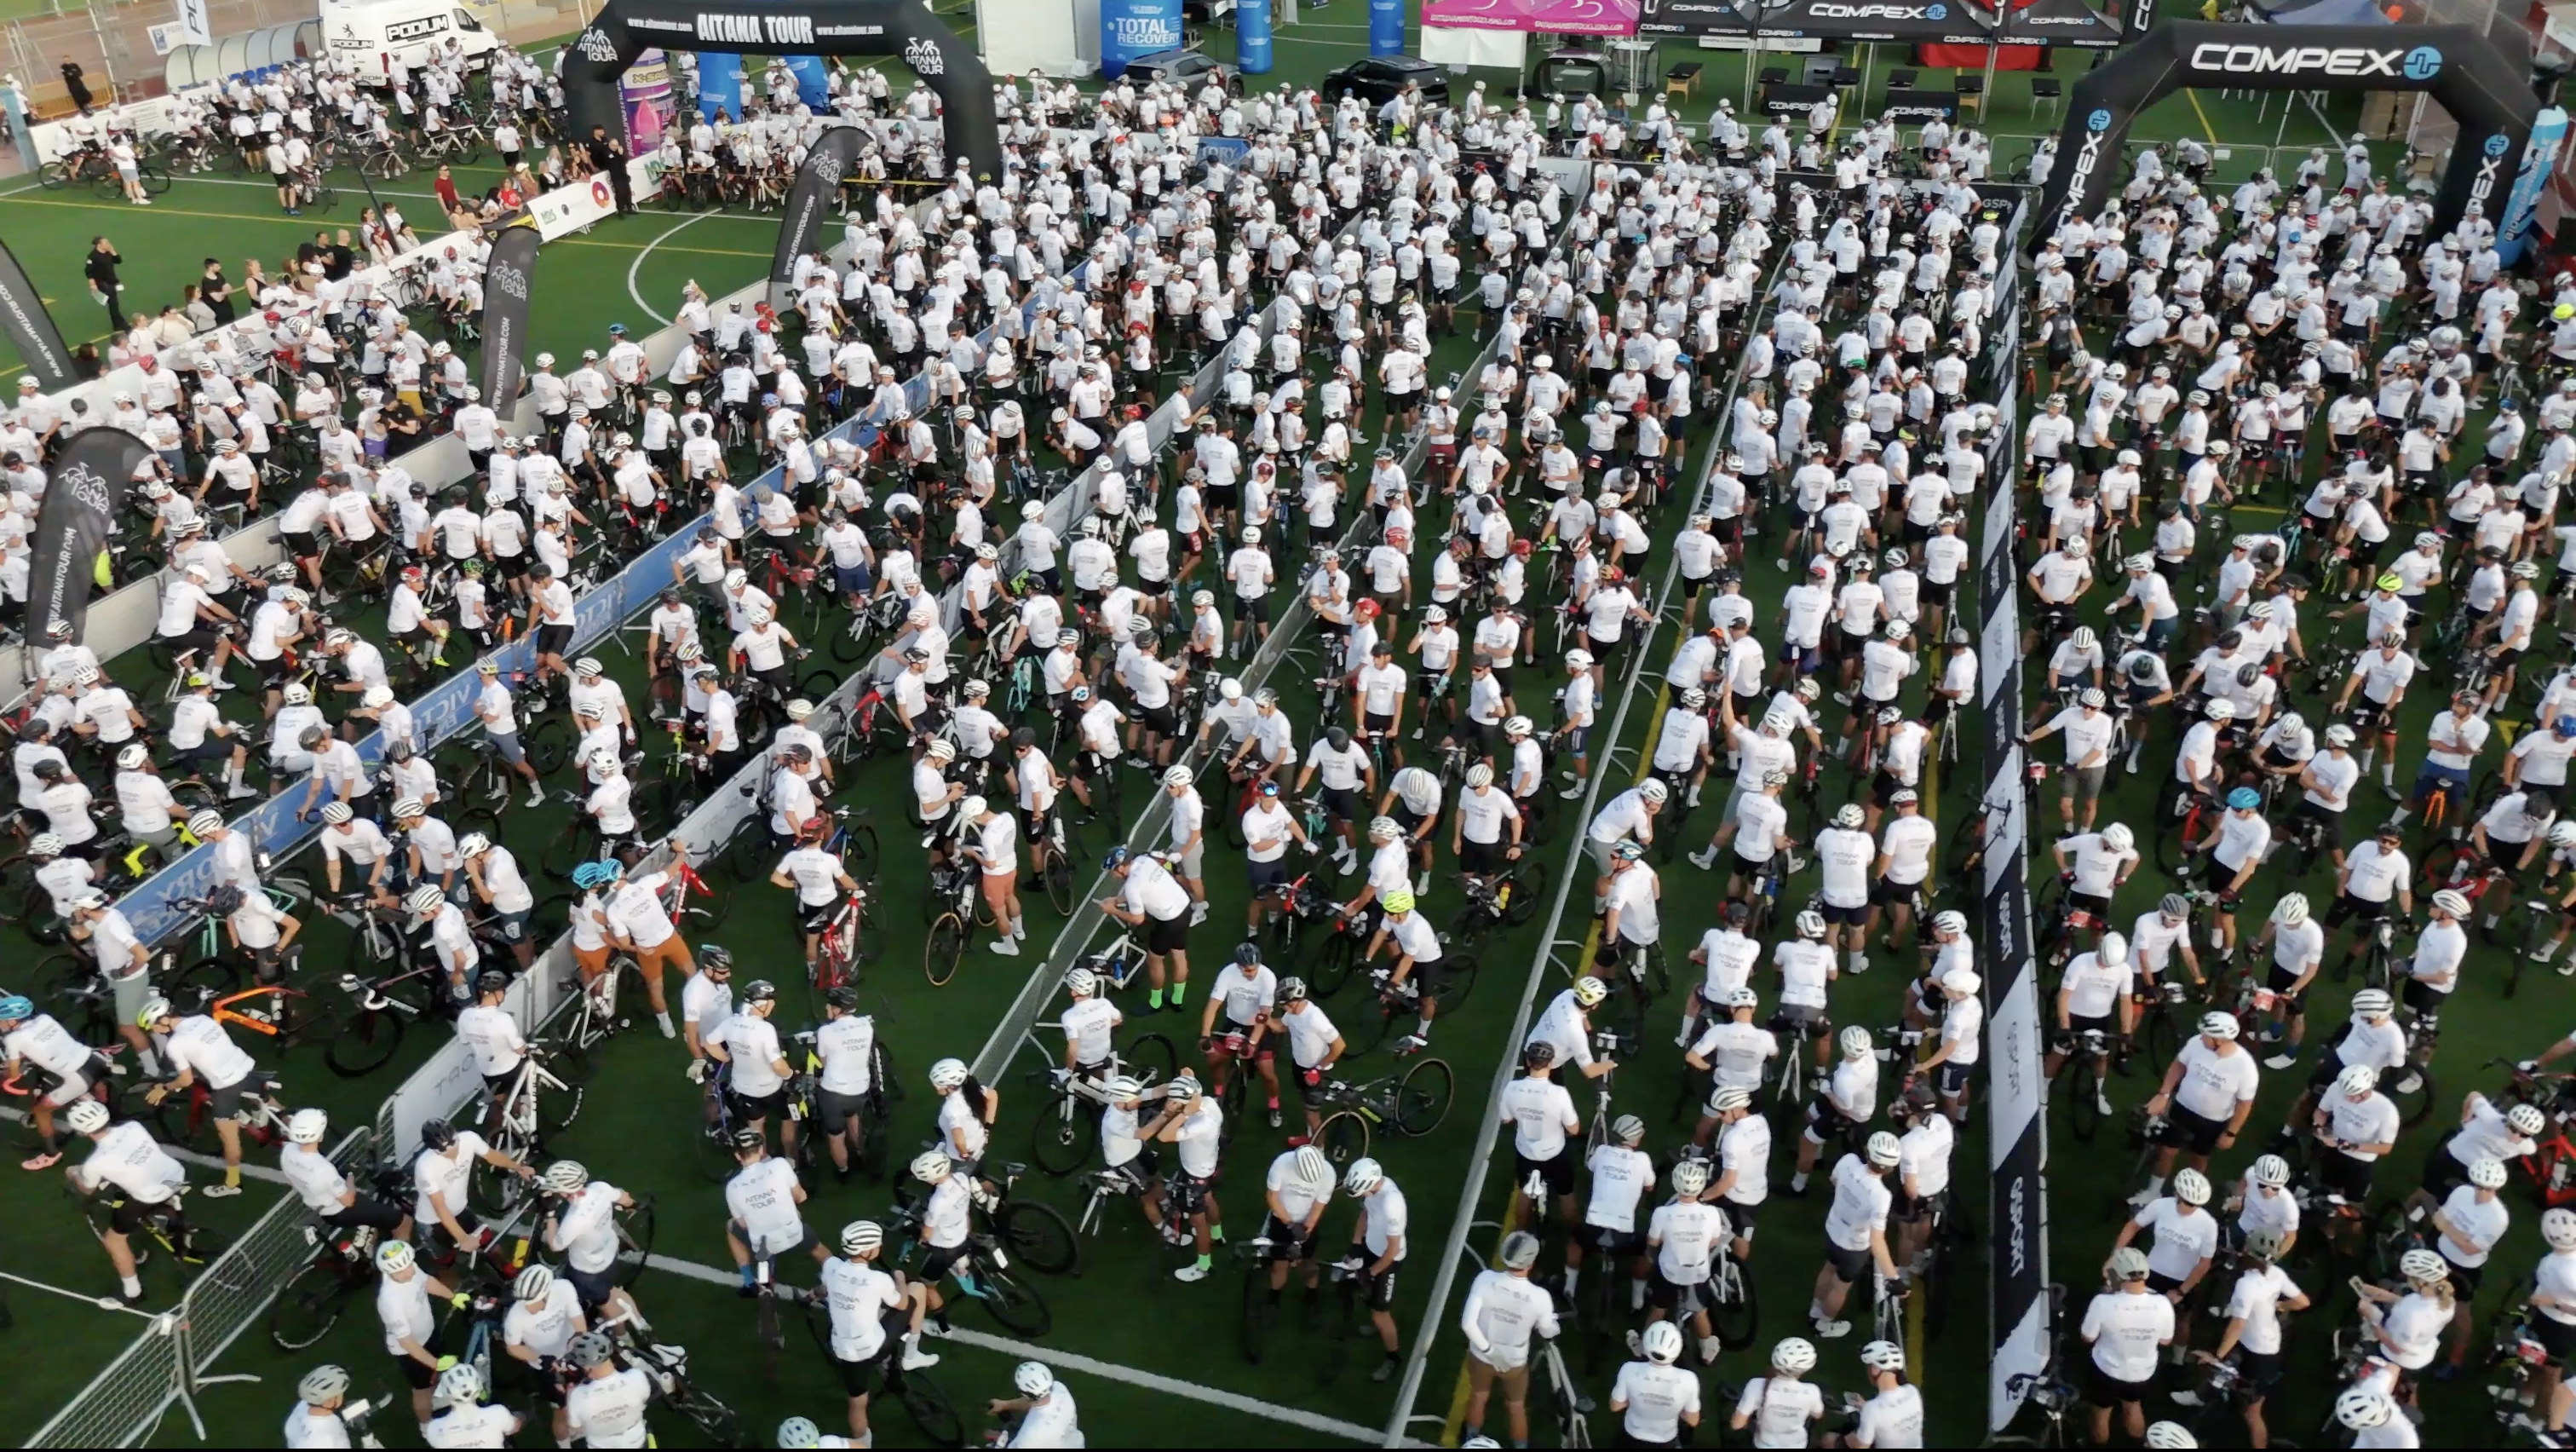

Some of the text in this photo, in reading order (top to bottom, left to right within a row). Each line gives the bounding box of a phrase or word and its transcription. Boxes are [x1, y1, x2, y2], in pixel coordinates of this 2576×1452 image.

[1671, 4, 1720, 13] COMPEX
[1809, 3, 1927, 19] COMPEX
[388, 15, 448, 41] PODIUM
[697, 14, 814, 43] AITANA TOUR
[1116, 18, 1169, 34] TOTAL
[1641, 24, 1676, 32] COMPEX
[1118, 32, 1180, 44] RECOVERY
[2190, 43, 2404, 76] COMPEX
[745, 1189, 776, 1203] AITANA
